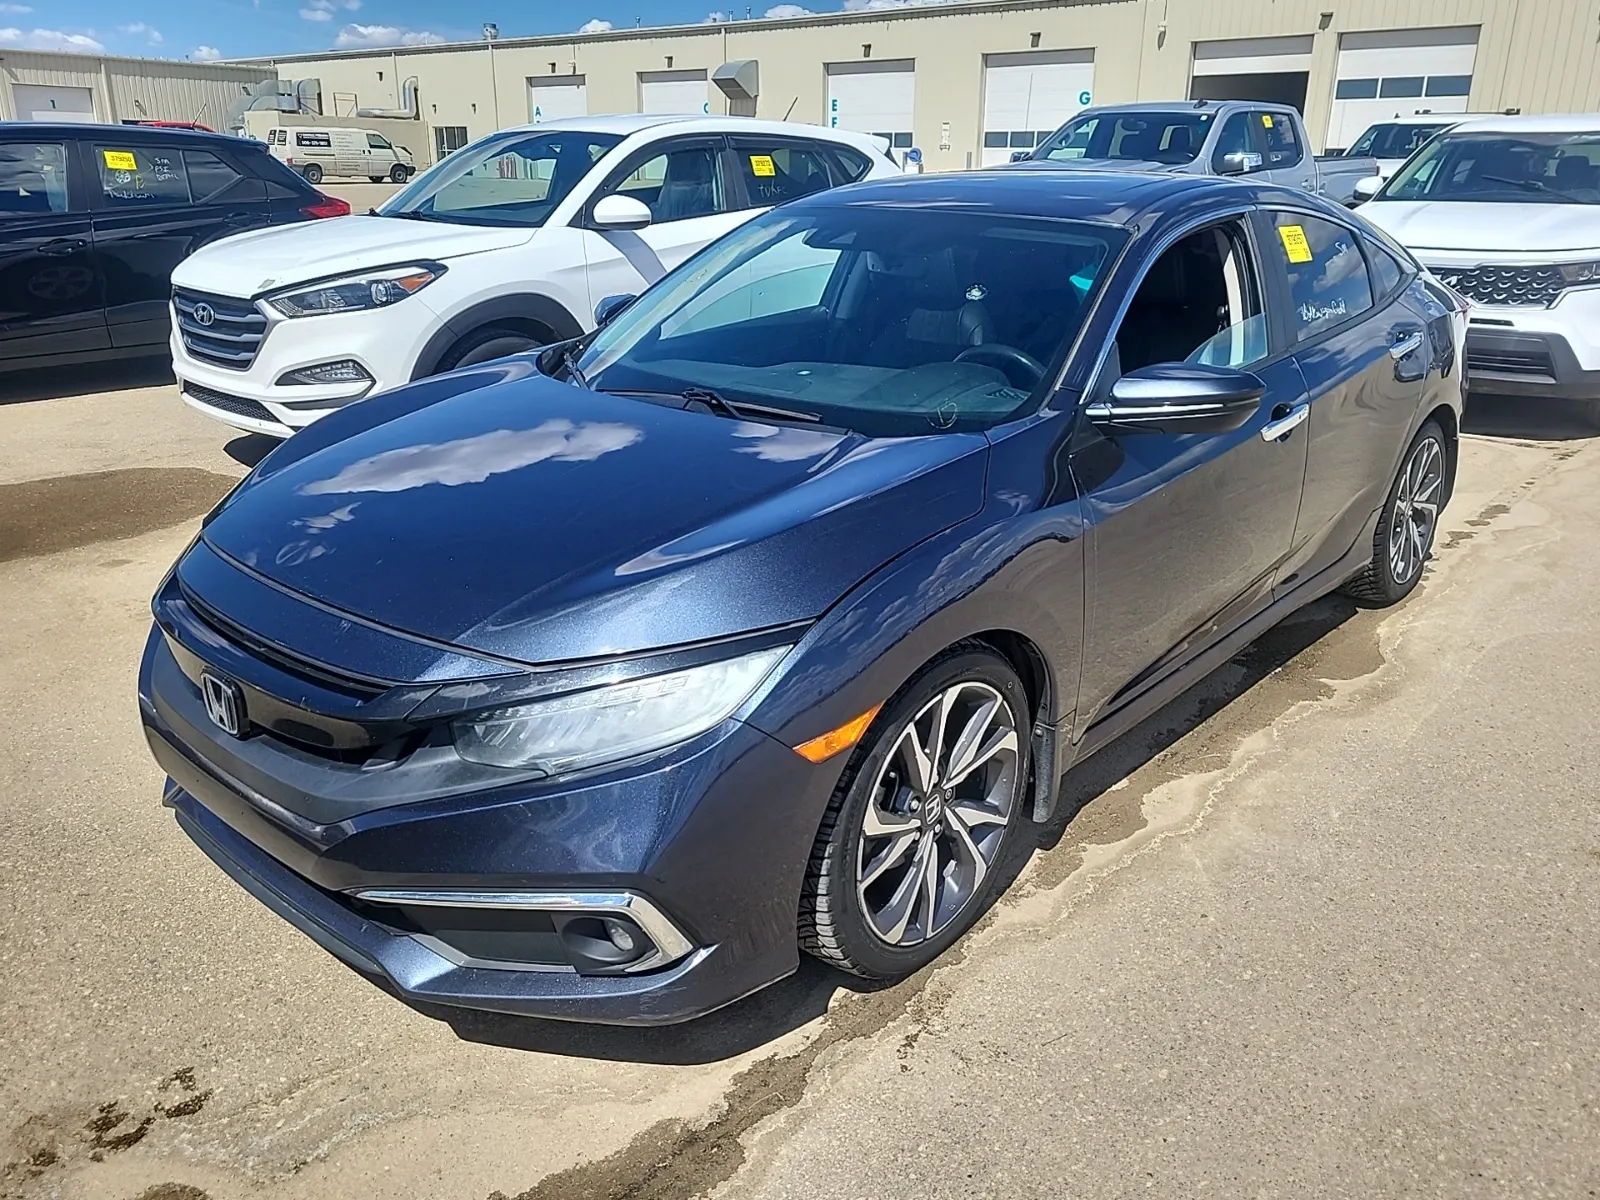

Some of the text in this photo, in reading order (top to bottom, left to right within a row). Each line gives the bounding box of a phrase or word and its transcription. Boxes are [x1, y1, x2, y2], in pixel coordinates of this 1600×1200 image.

[1079, 91, 1091, 105] G
[535, 106, 542, 116] A
[832, 99, 838, 112] E
